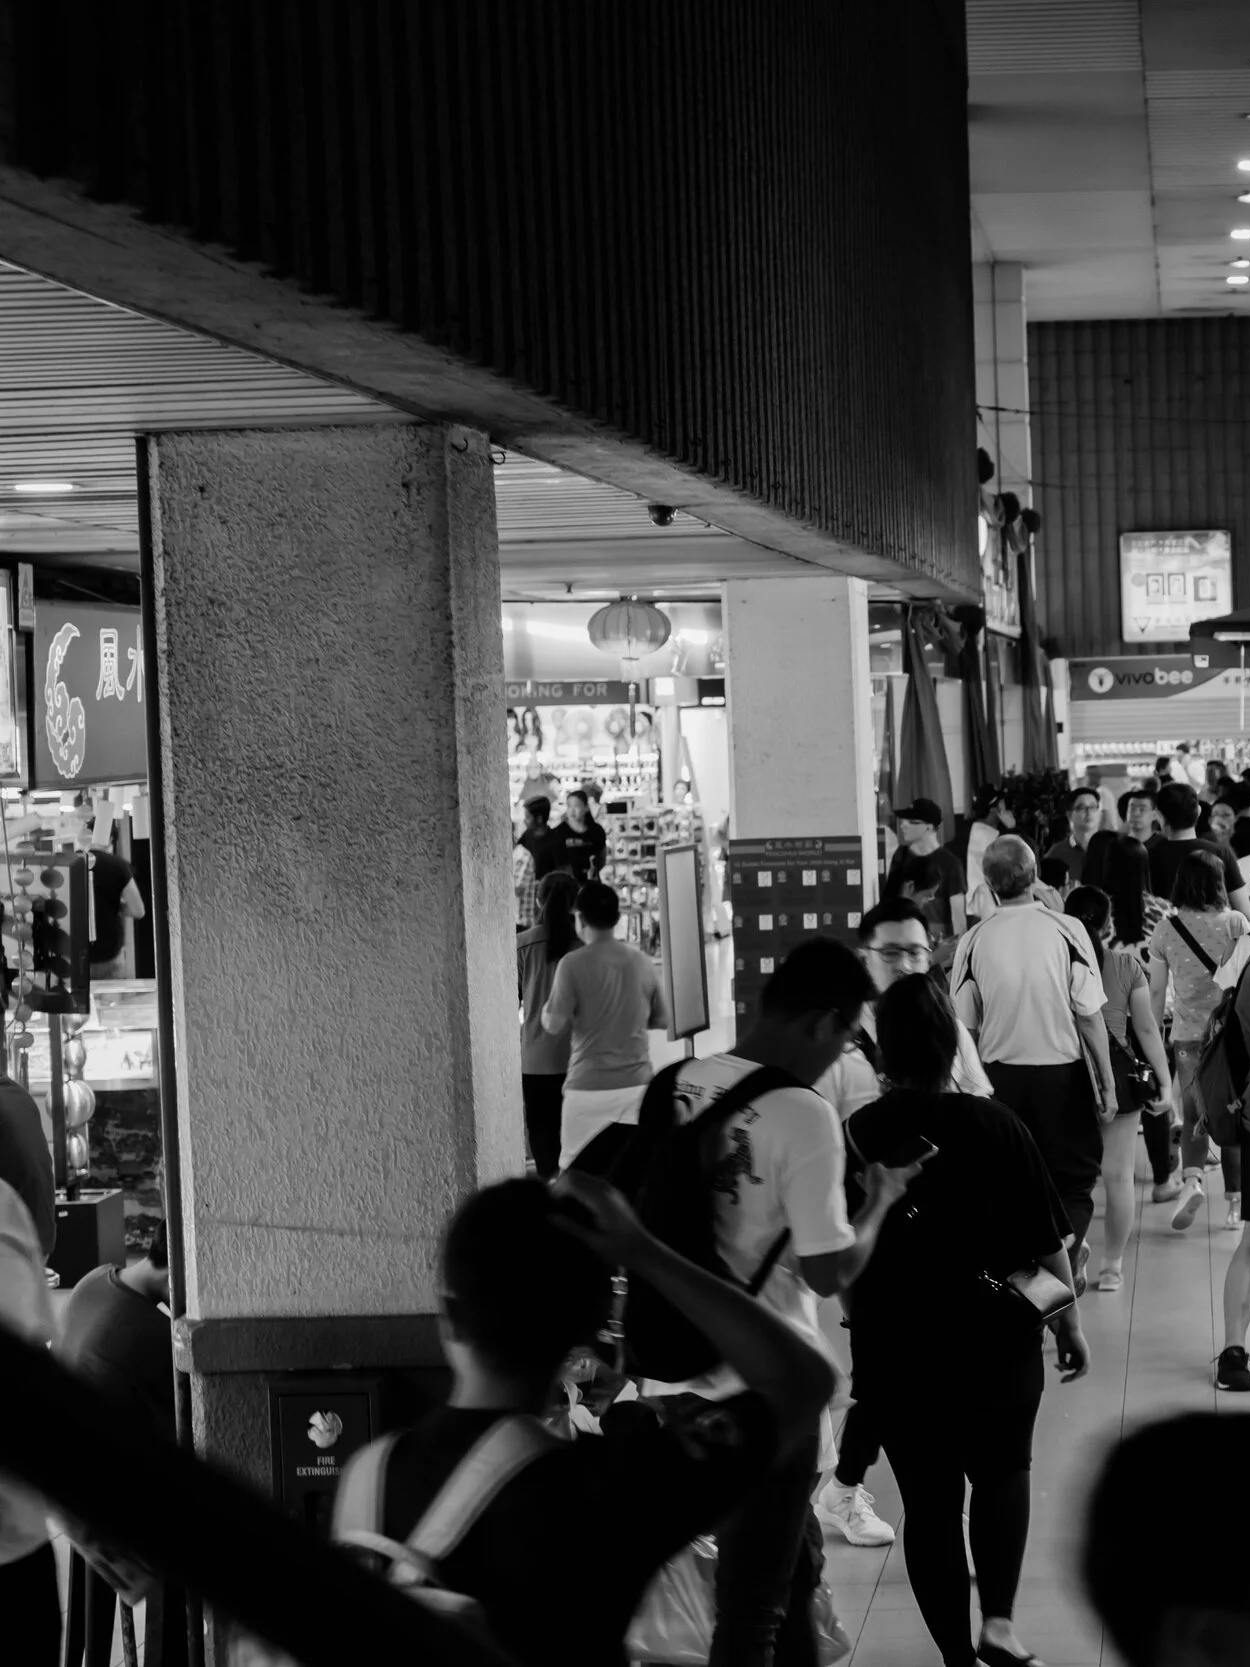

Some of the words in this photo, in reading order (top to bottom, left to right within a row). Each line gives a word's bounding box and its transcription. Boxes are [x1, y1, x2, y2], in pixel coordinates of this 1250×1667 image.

[1116, 667, 1194, 685] vivobee
[573, 683, 608, 697] FOR
[317, 1456, 335, 1466] FIRE
